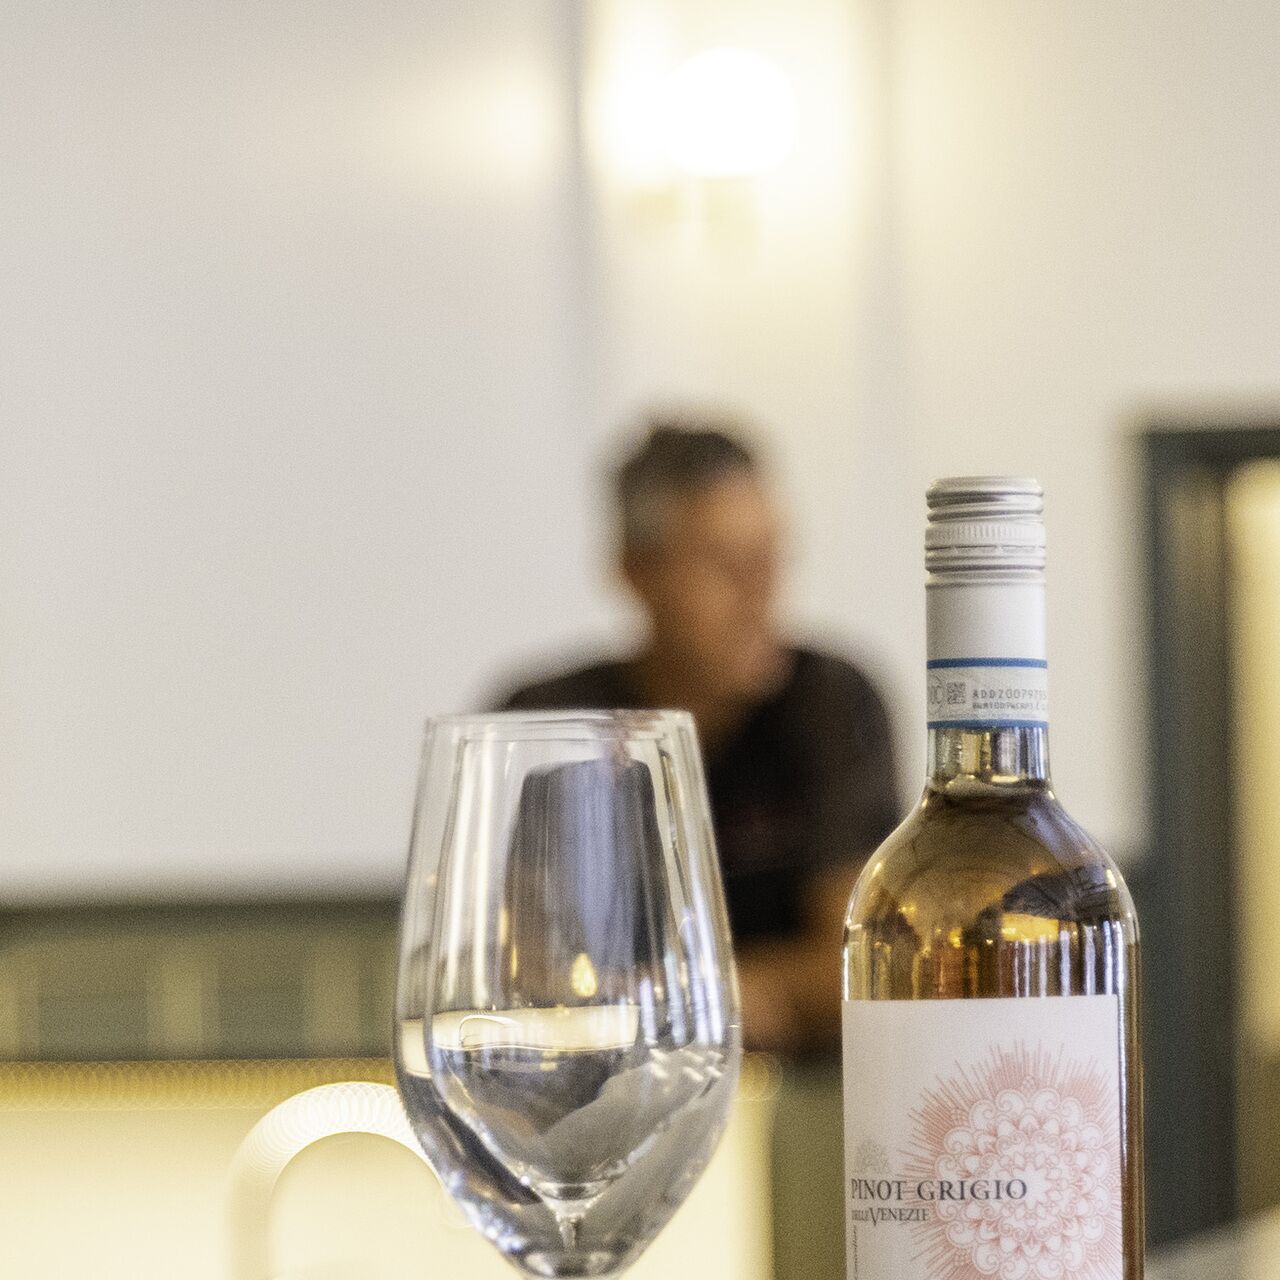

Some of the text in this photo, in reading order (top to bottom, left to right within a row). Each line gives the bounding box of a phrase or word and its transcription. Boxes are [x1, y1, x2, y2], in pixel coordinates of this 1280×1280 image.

[851, 1178, 1027, 1200] PINOT GRIGIO
[869, 1207, 929, 1226] VENEZIE
